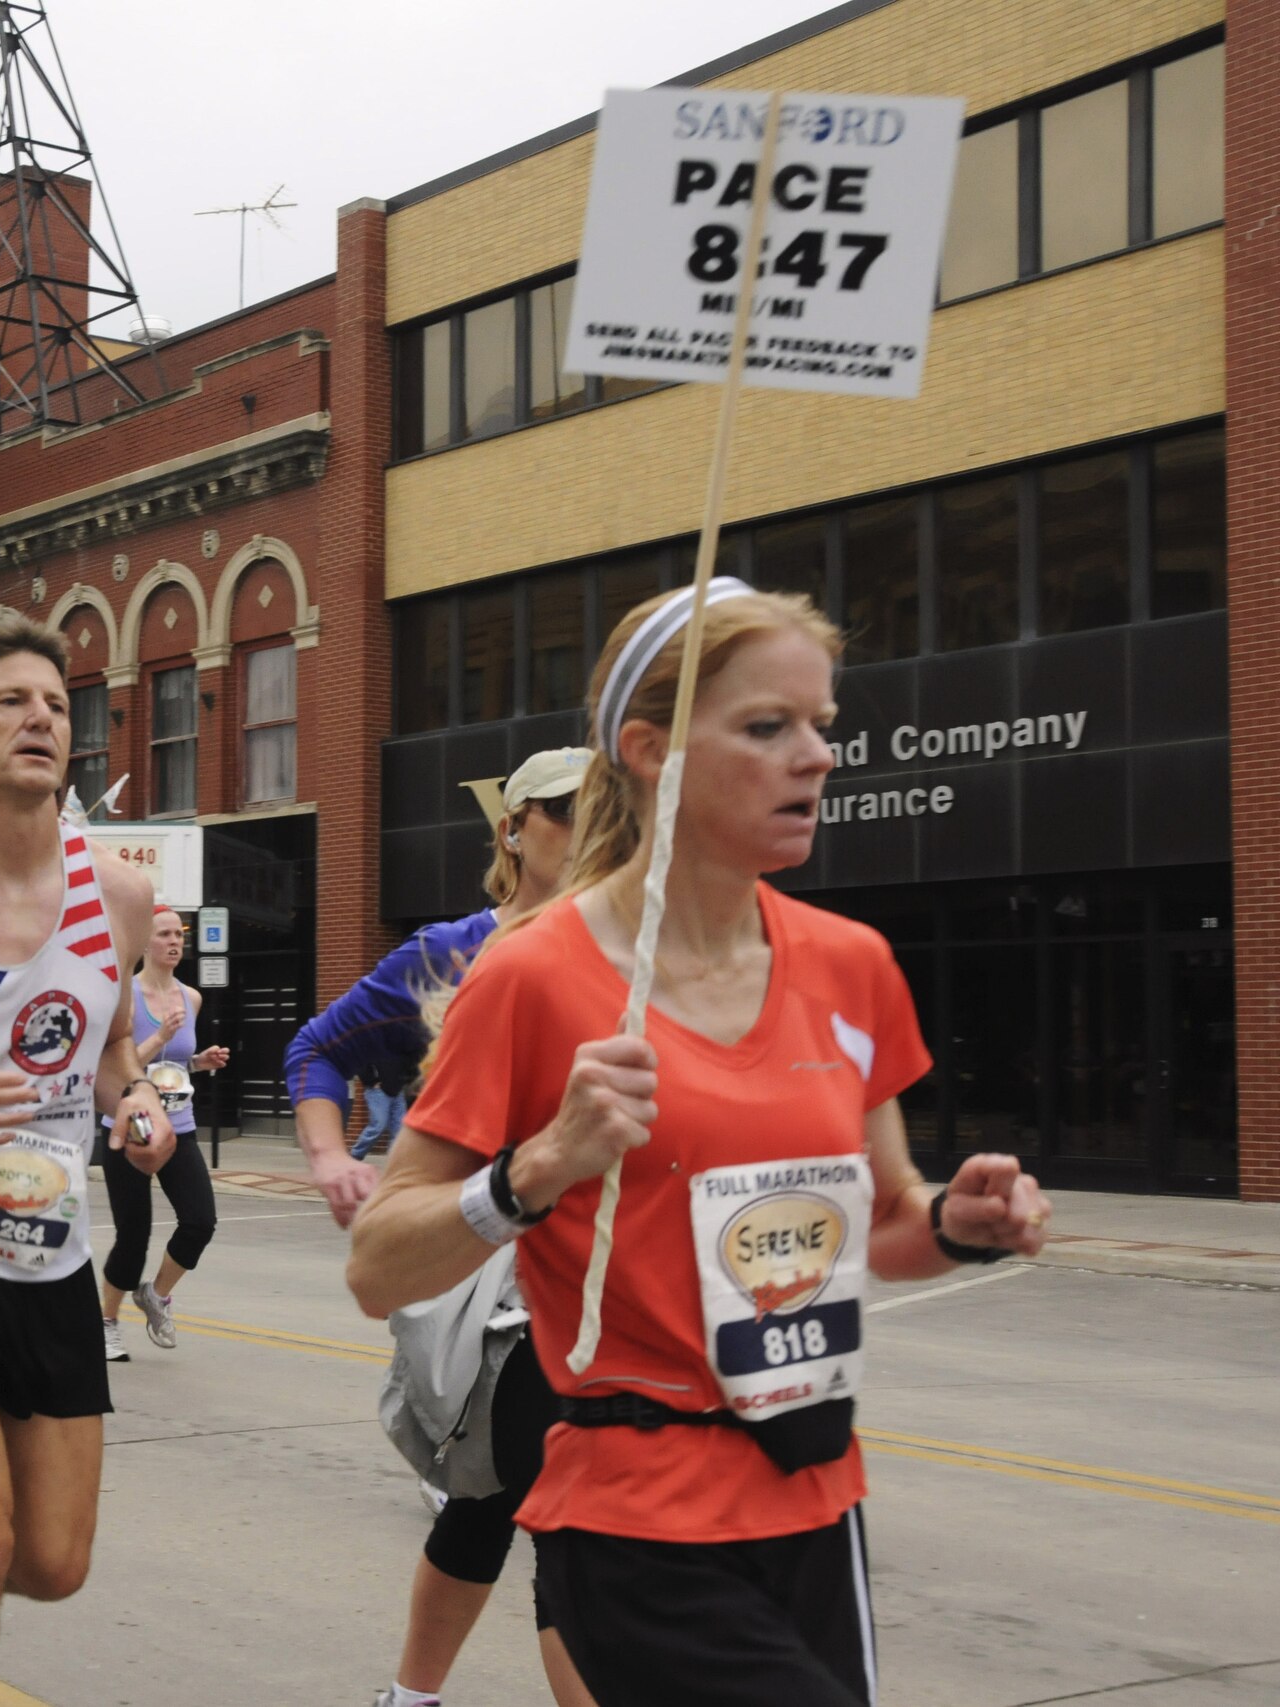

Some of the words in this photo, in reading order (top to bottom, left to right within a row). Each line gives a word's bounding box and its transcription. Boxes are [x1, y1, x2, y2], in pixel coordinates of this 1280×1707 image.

[671, 160, 872, 213] PACE
[687, 224, 890, 291] 8:47
[699, 293, 805, 319] MI/MI
[584, 321, 640, 340] SEND
[645, 326, 682, 344] ALL
[689, 330, 760, 349] PACR
[767, 334, 882, 358] FEEDBACK
[887, 345, 917, 362] TO
[826, 731, 869, 768] nd
[890, 710, 1088, 761] Company
[820, 785, 954, 824] urance
[119, 847, 156, 865] 940
[705, 1177, 750, 1198] FULL
[756, 1163, 858, 1192] MARATHON
[736, 1219, 828, 1264] SERENE
[762, 1318, 828, 1366] 818
